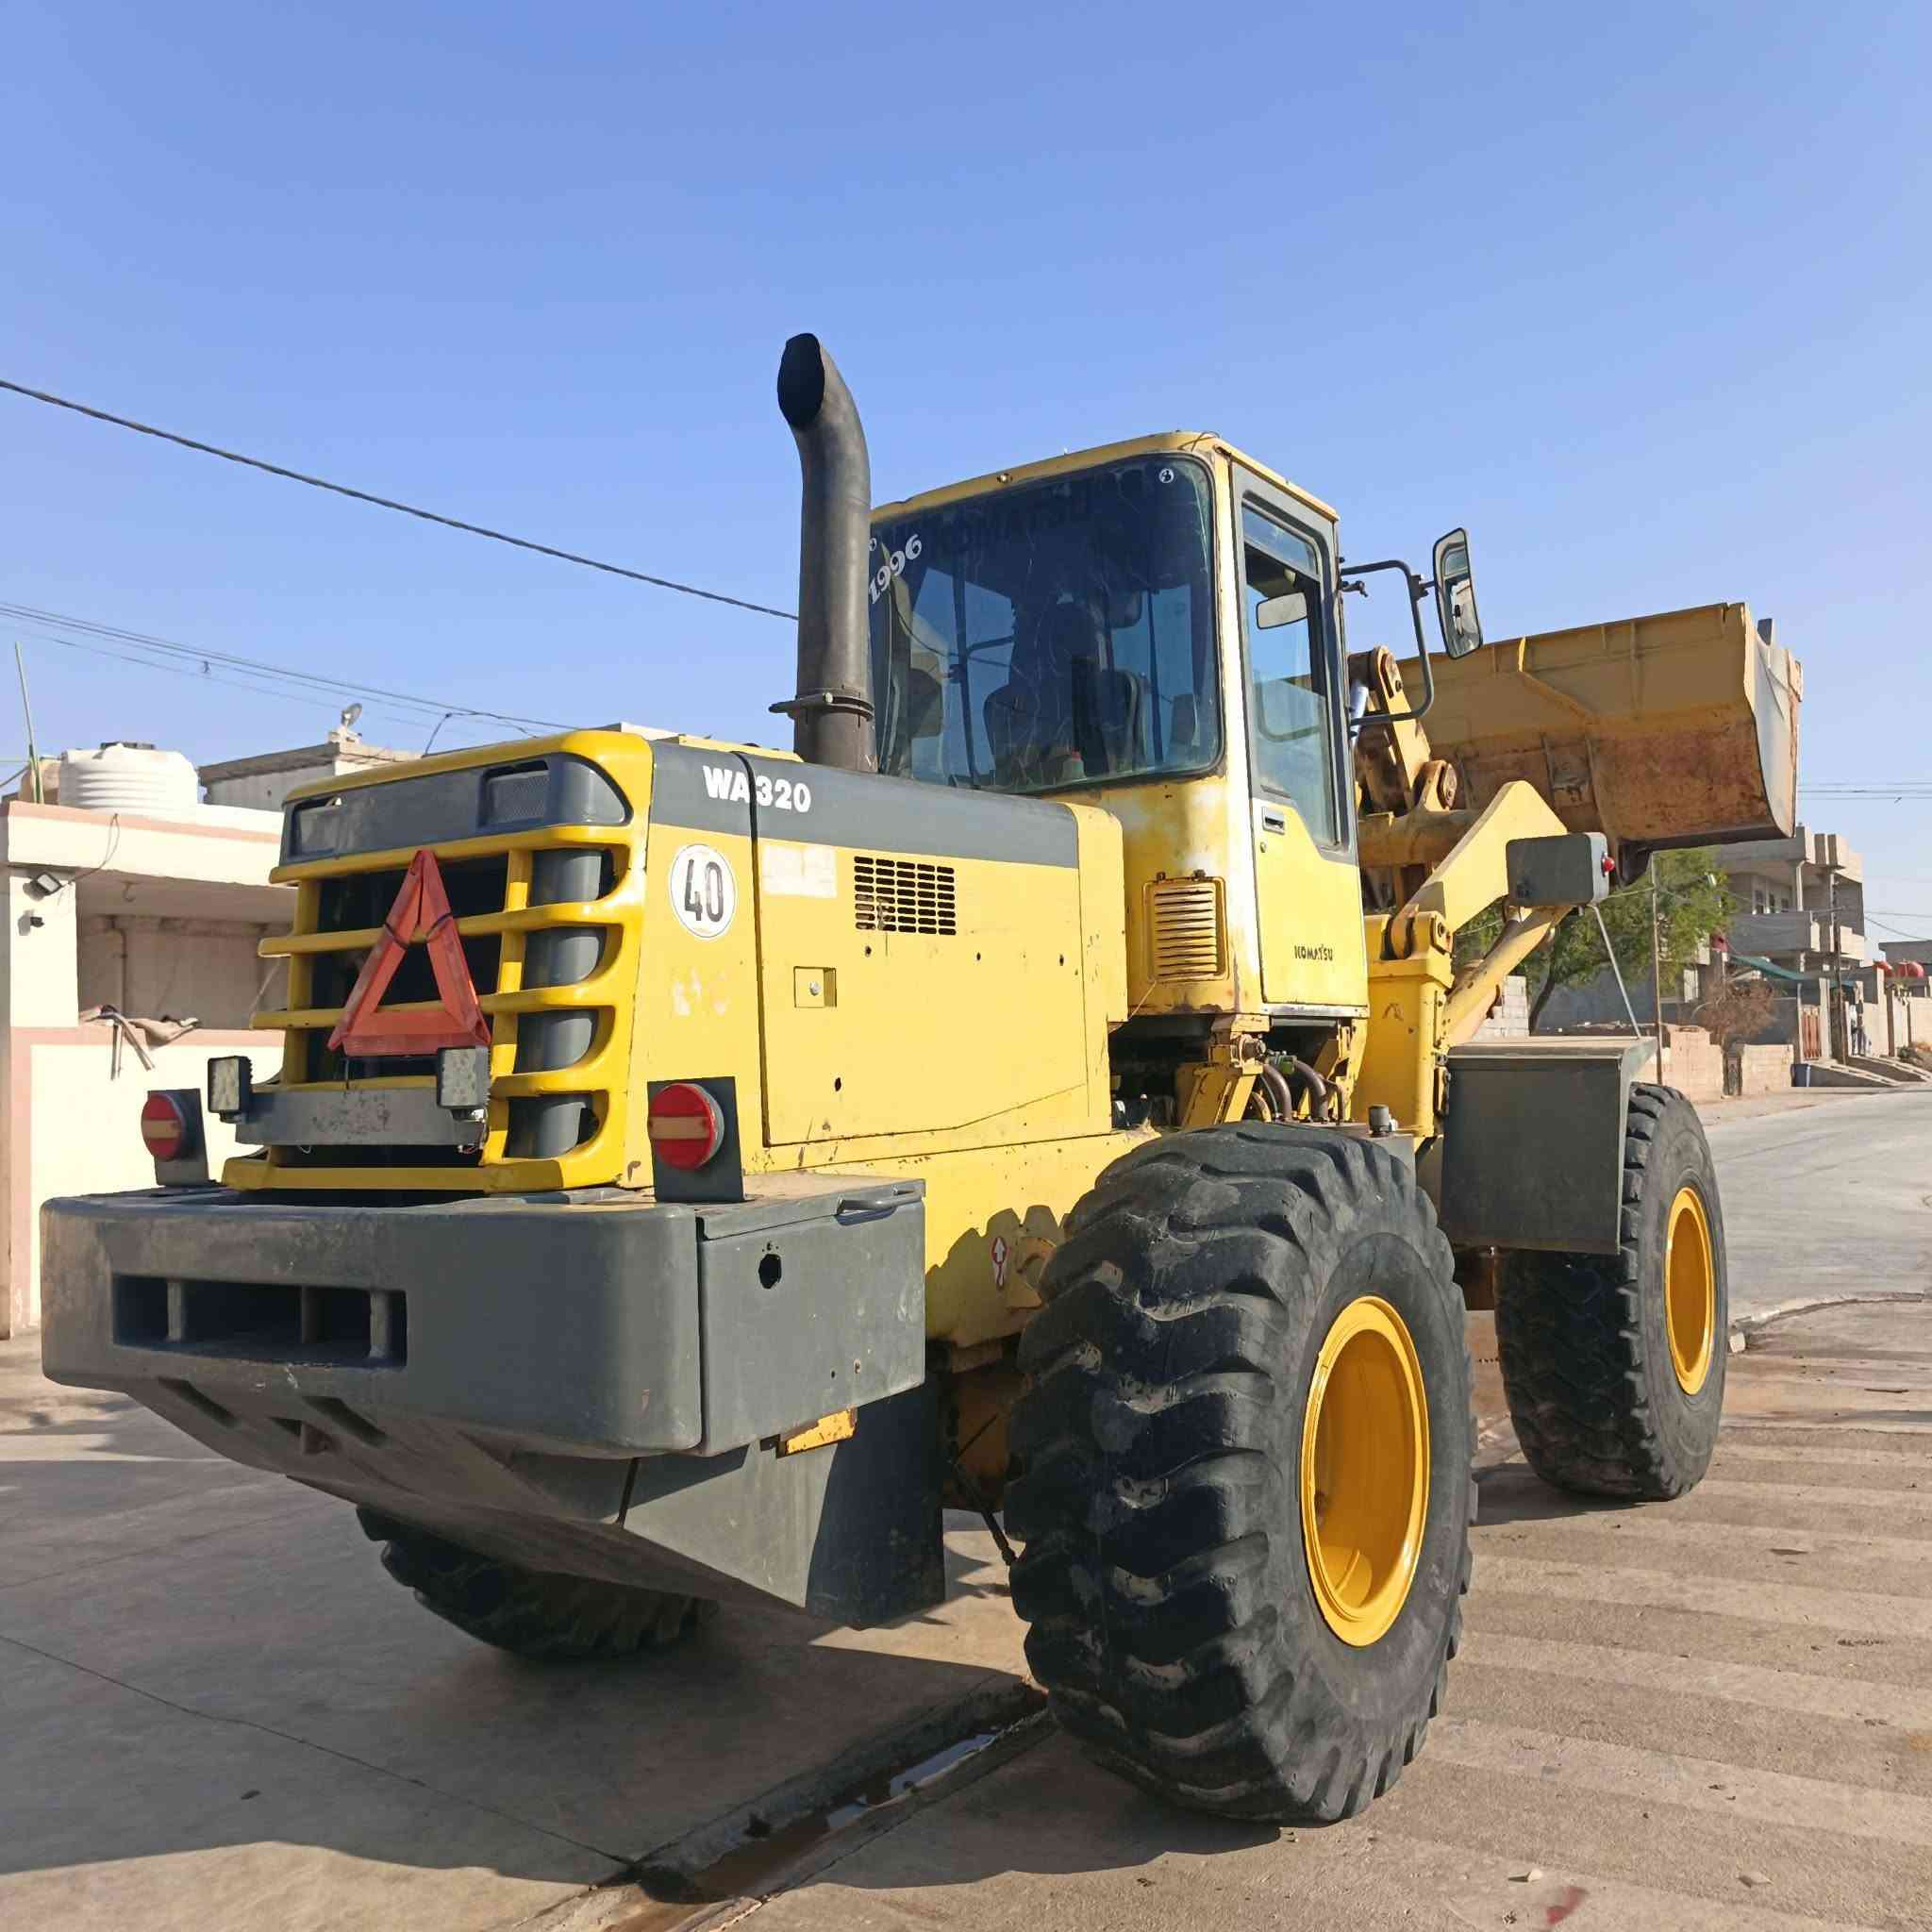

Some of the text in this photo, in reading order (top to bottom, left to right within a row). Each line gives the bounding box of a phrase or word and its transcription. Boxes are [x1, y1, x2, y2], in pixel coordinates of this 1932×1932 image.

[869, 534, 923, 604] 1996
[684, 858, 724, 923] 40
[1293, 944, 1333, 961] KOMATSU
